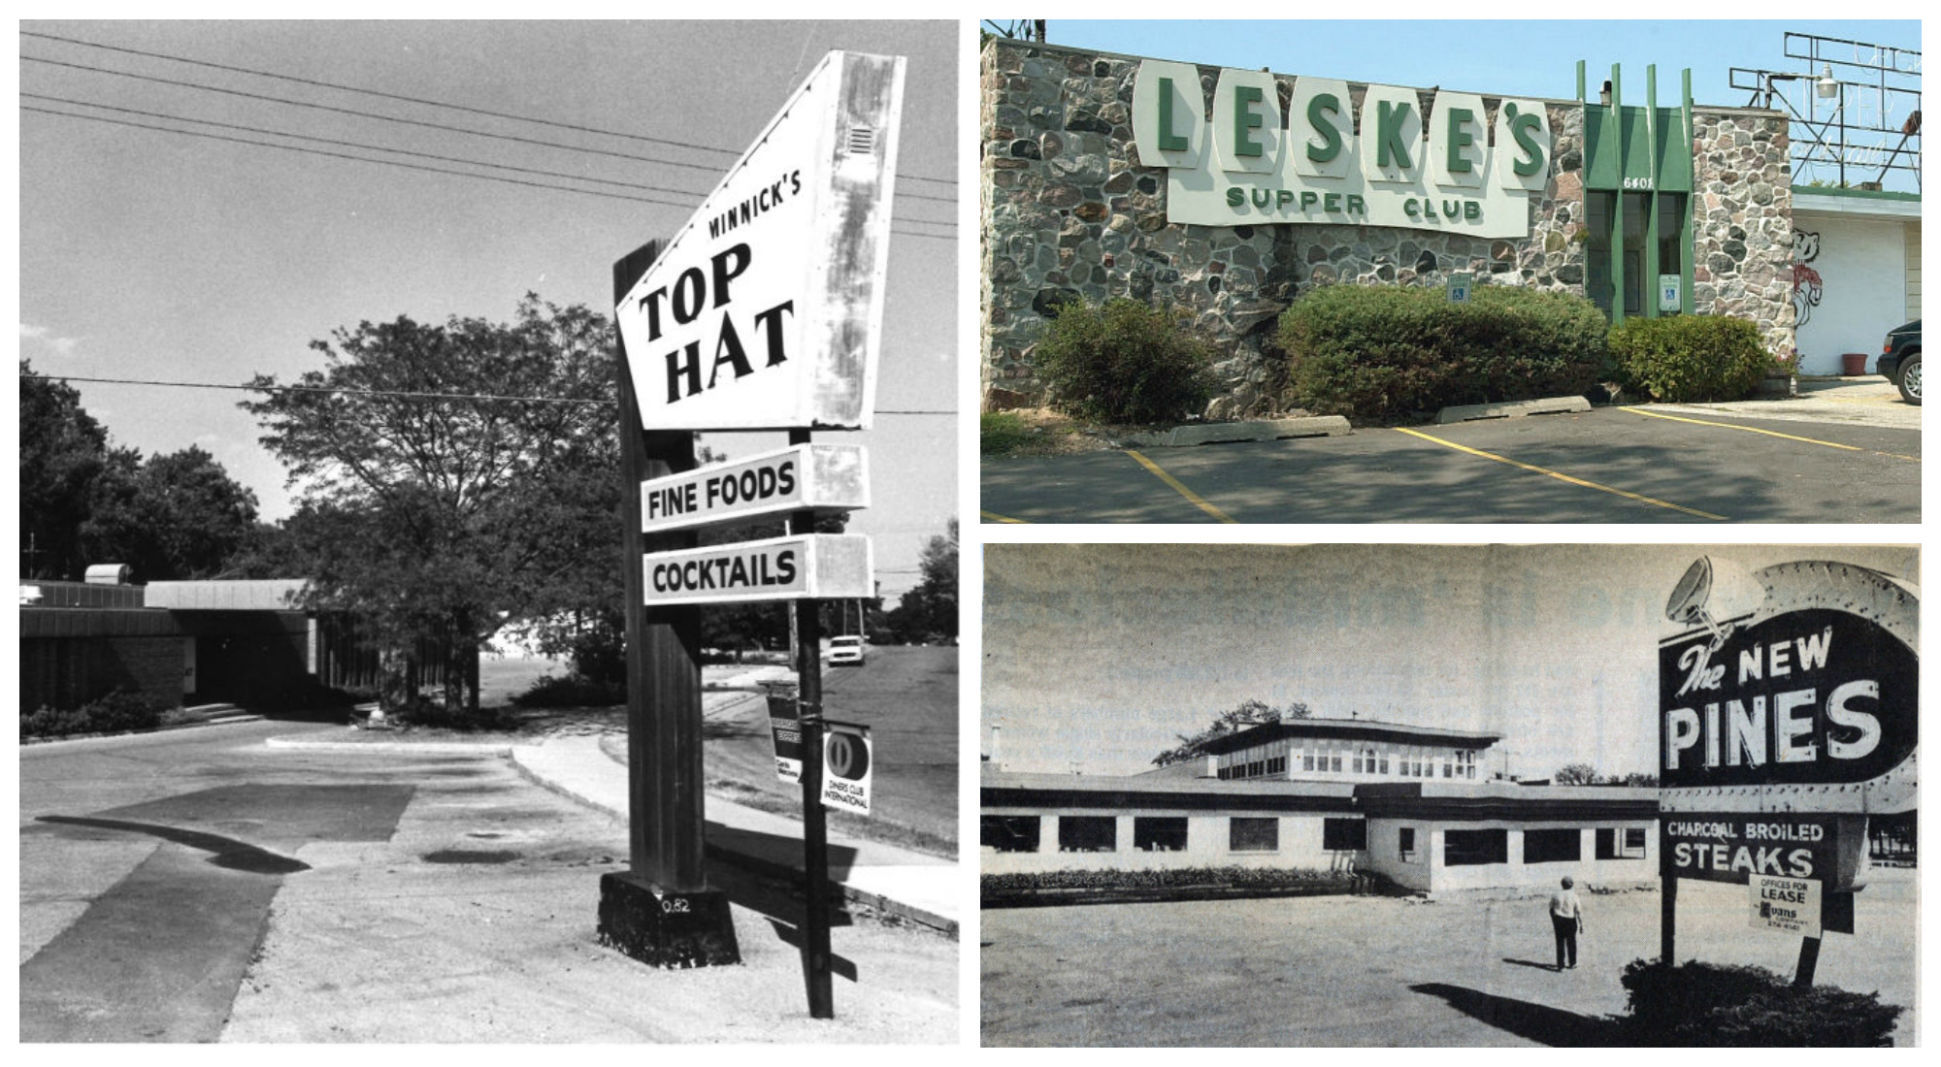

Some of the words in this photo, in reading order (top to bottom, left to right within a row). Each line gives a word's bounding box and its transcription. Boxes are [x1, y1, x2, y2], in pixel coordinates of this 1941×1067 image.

[1157, 76, 1544, 177] LESKE'S
[708, 169, 802, 240] MINNICK'S
[1226, 186, 1365, 215] SUPPER
[1403, 198, 1481, 219] CLUB
[639, 242, 752, 343] TOP
[665, 299, 794, 404] HAT
[648, 483, 698, 519] FINE
[706, 461, 796, 509] FOODS
[652, 550, 797, 592] COCKTAILS
[1674, 634, 1727, 699] The
[1738, 625, 1833, 686] NEW
[1665, 679, 1882, 770] PINES
[1667, 821, 1738, 839] CHARCOAL
[1746, 823, 1824, 842] BROILED
[1674, 842, 1814, 878] STEAKS
[1760, 879, 1791, 890] OFFICES
[1793, 882, 1808, 891] FOR
[1761, 888, 1806, 904] LEASE
